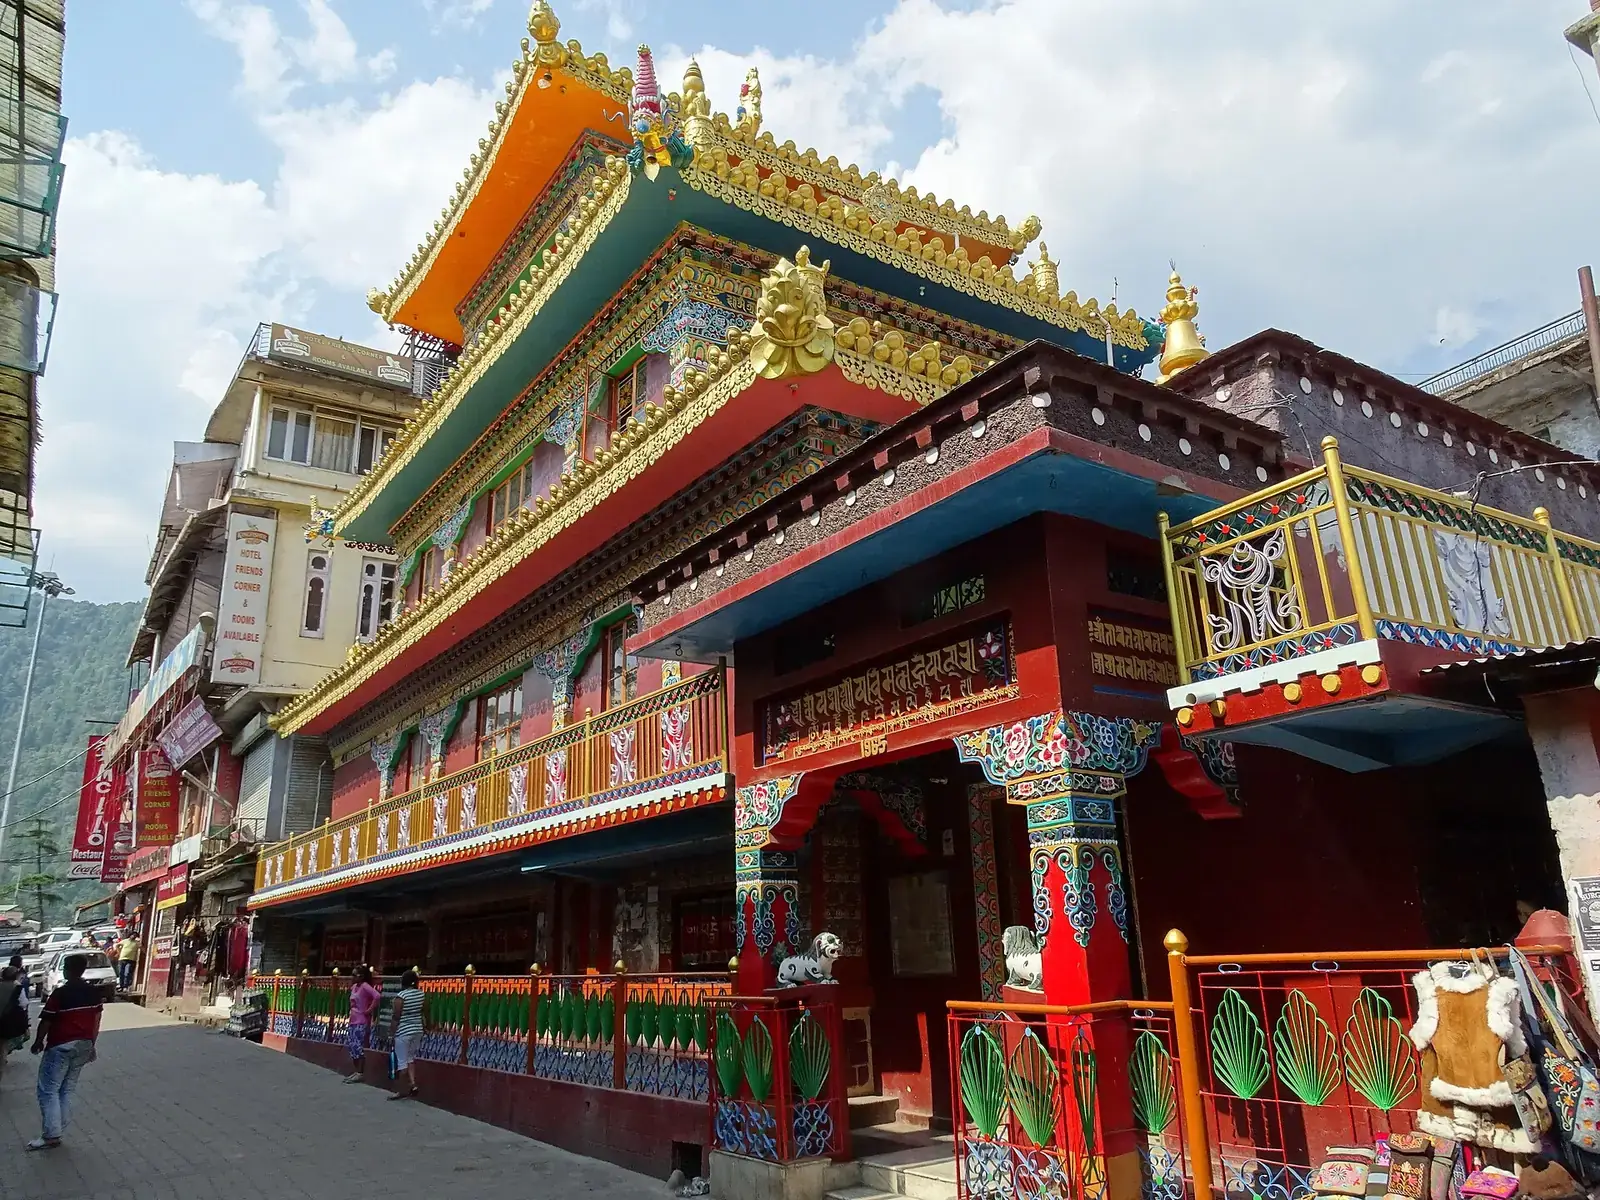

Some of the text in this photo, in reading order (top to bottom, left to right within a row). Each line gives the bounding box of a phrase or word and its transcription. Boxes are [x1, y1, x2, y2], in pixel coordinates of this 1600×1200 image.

[304, 336, 384, 360] HOTEL FRIENDS CORNER
[312, 356, 373, 376] ROOMS AVAILABLE
[240, 549, 262, 560] HOTEL
[235, 564, 264, 577] FRIENDS
[233, 581, 261, 593] CORNER
[242, 598, 248, 608] &
[231, 614, 256, 625] ROOMS
[223, 630, 260, 643] AVAILABLE
[139, 833, 174, 841] AVAILABLE
[73, 849, 103, 859] Restaur
[1582, 891, 1600, 901] BURG
